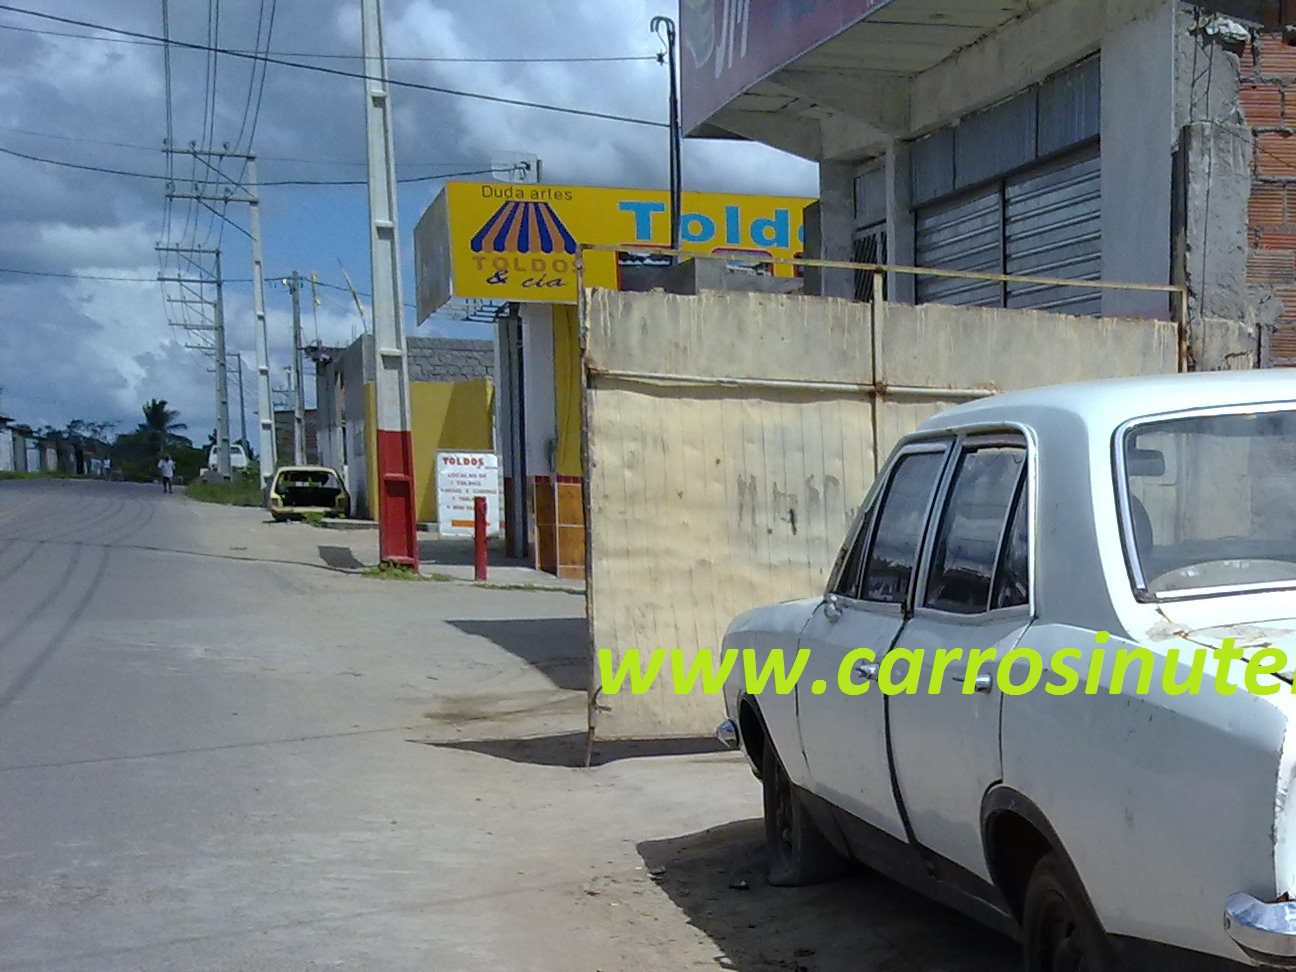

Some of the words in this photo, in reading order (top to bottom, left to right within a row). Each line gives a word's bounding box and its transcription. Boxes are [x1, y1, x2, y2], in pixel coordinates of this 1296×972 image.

[482, 185, 524, 198] Duda
[617, 200, 804, 248] Told
[486, 269, 509, 285] &
[443, 457, 485, 466] TOLDOS
